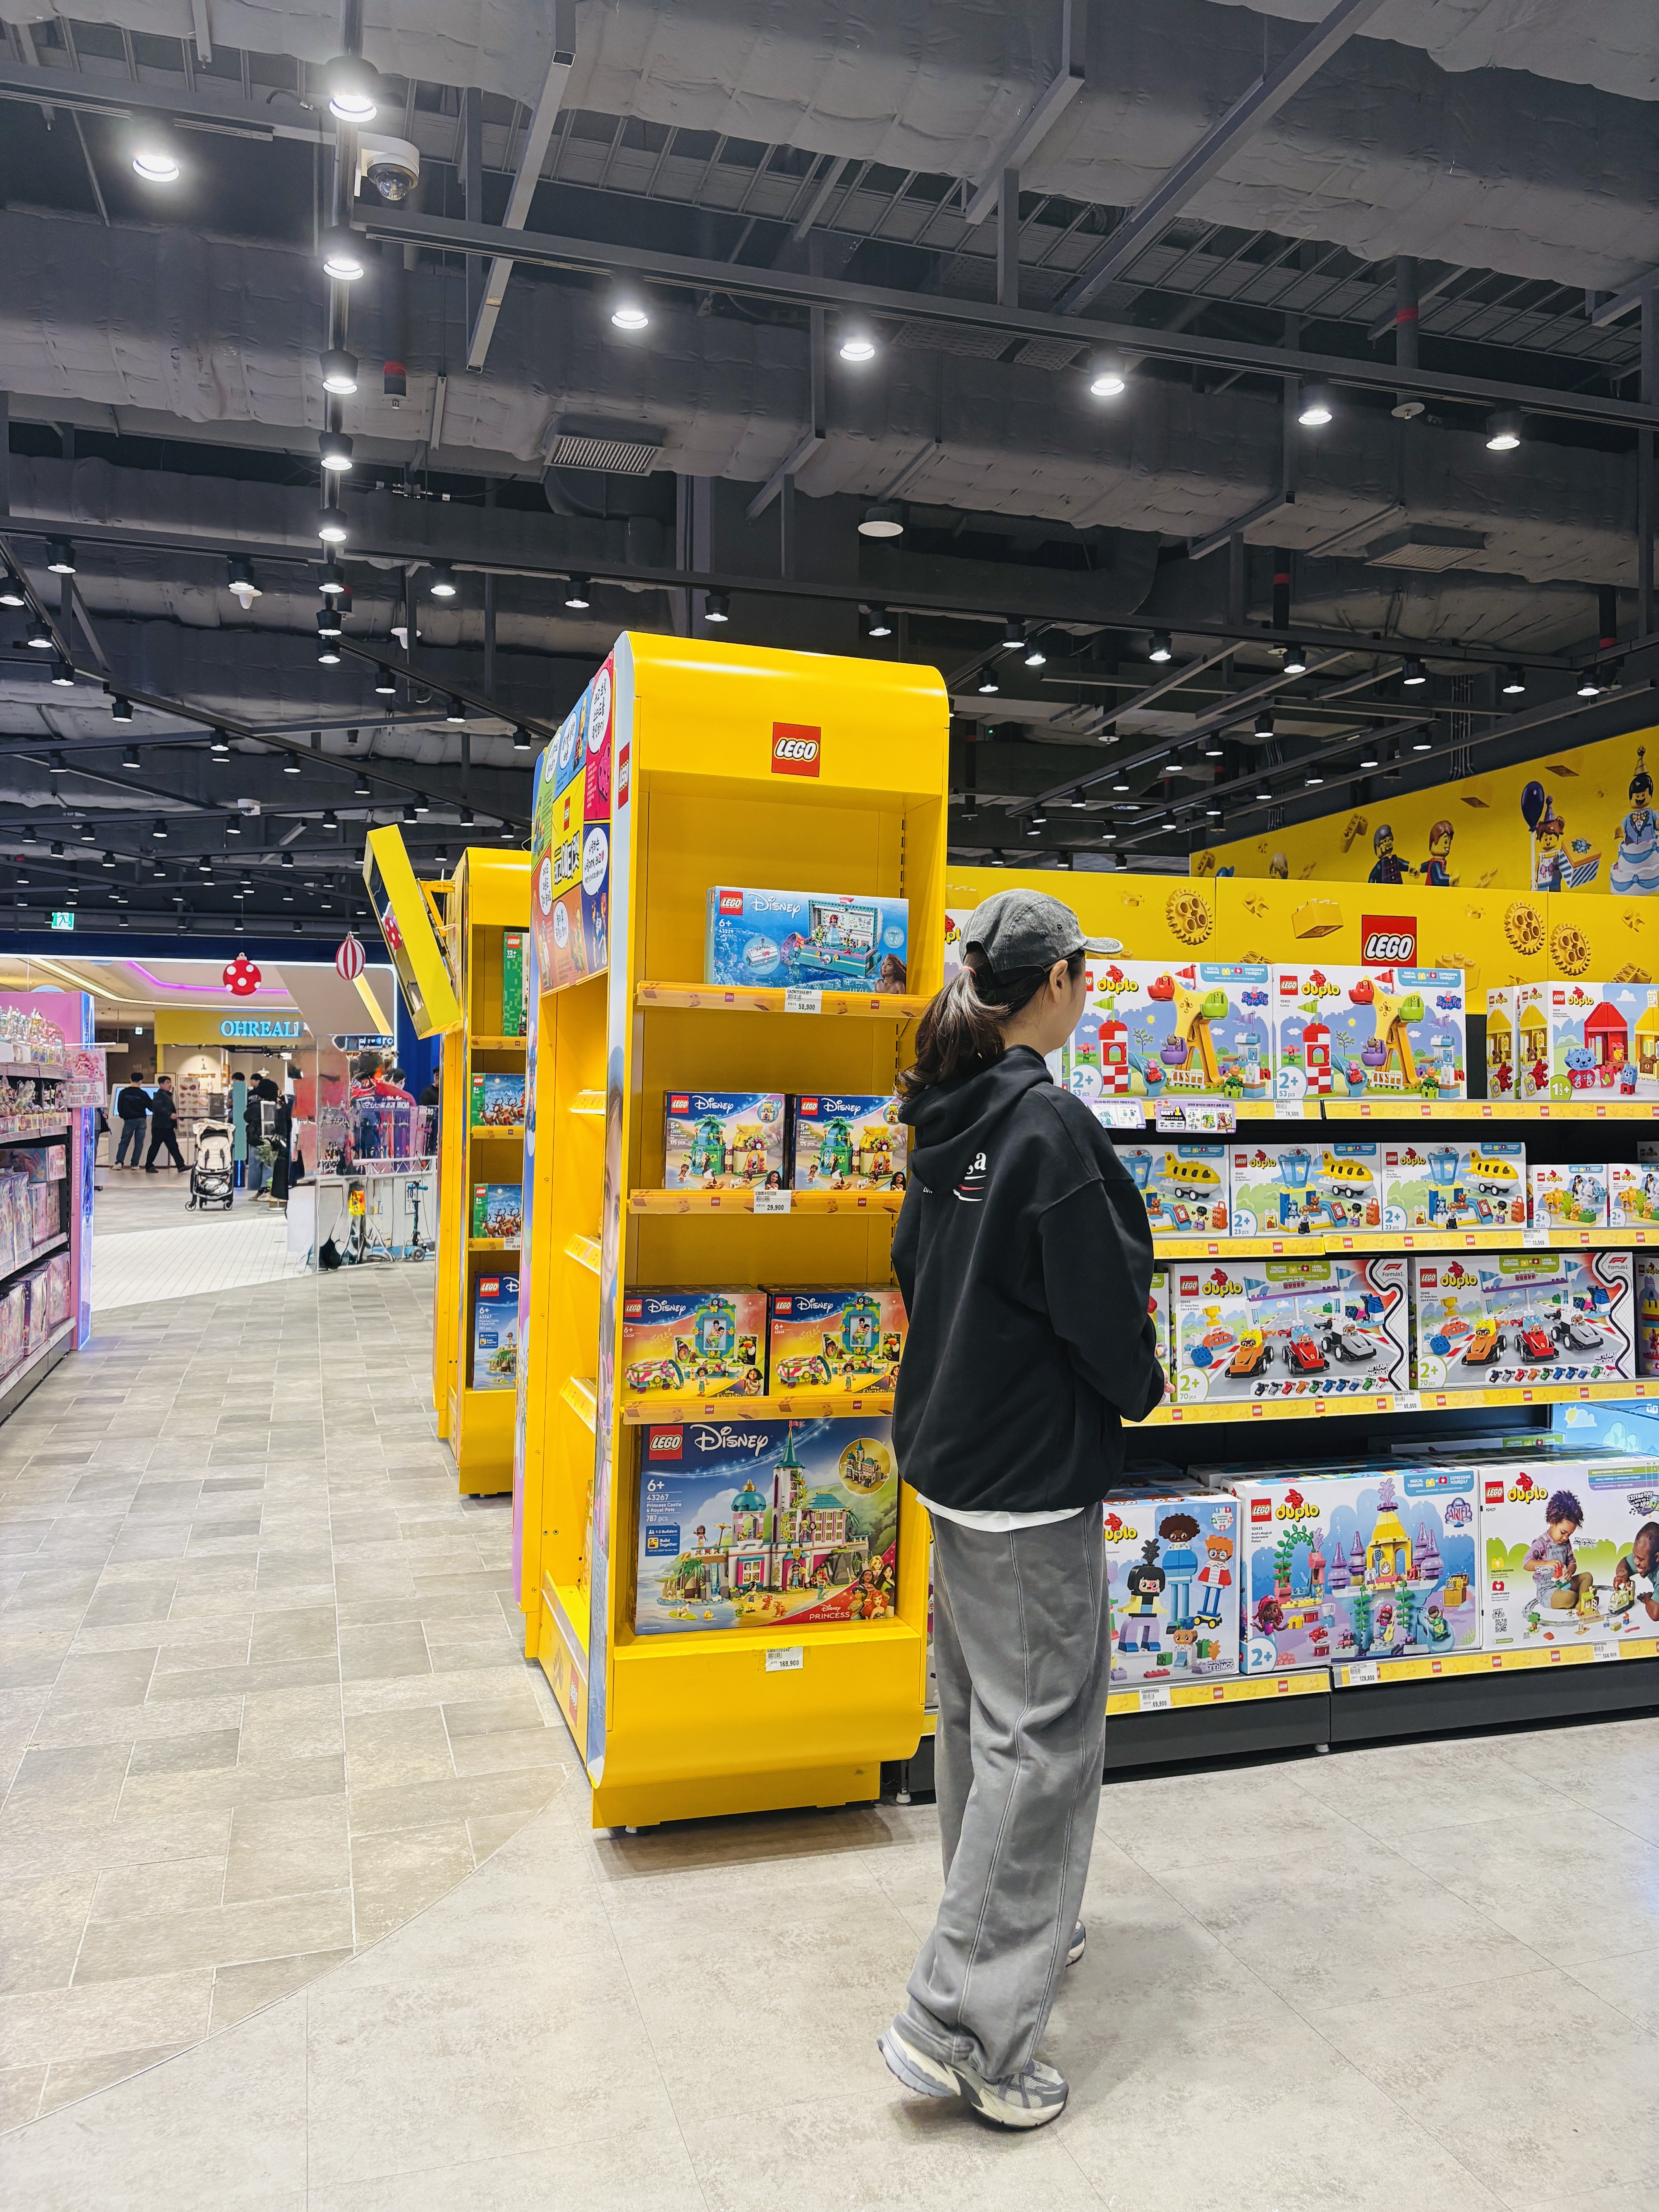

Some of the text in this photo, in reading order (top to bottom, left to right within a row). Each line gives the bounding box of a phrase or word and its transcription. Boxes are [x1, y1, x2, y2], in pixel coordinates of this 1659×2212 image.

[775, 738, 818, 761] LEGO
[721, 897, 742, 908] LEGO
[1364, 933, 1414, 961] LEGO
[1097, 979, 1139, 994] duplo
[1281, 981, 1340, 998] LEGO duplo
[1242, 993, 1267, 1006] Peppa Pig
[1437, 996, 1461, 1007] Peppa Pig
[1568, 995, 1594, 1007] duplo
[1073, 1071, 1094, 1089] 2+
[1279, 1072, 1298, 1089] 2+
[397, 1101, 410, 1109] MICRO
[672, 1100, 689, 1108] LEGO
[802, 1103, 818, 1111] LEGO
[419, 1108, 434, 1116] MICRO
[1249, 1158, 1276, 1170] duplo
[1400, 1156, 1426, 1167] duplo
[1234, 1214, 1250, 1227] 2+
[1385, 1211, 1400, 1223] 2+
[481, 1283, 498, 1292] LEGO
[1440, 1273, 1478, 1290] duplo
[1182, 1281, 1243, 1298] LEGO duplo
[776, 1302, 791, 1310] LEGO
[1420, 1363, 1438, 1379] 2+
[1180, 1375, 1199, 1391] 2+
[651, 1435, 682, 1450] LEGO
[647, 1479, 665, 1492] 6+
[1486, 1488, 1548, 1504] LEGO duplo
[1252, 1502, 1320, 1523] LEGO duplo
[1448, 1506, 1470, 1521] ARIEL
[1104, 1525, 1138, 1544] uplo
[809, 1611, 850, 1620] PRINCESS
[1252, 1648, 1273, 1666] 2+
[1206, 1662, 1234, 1671] FEELINGS
